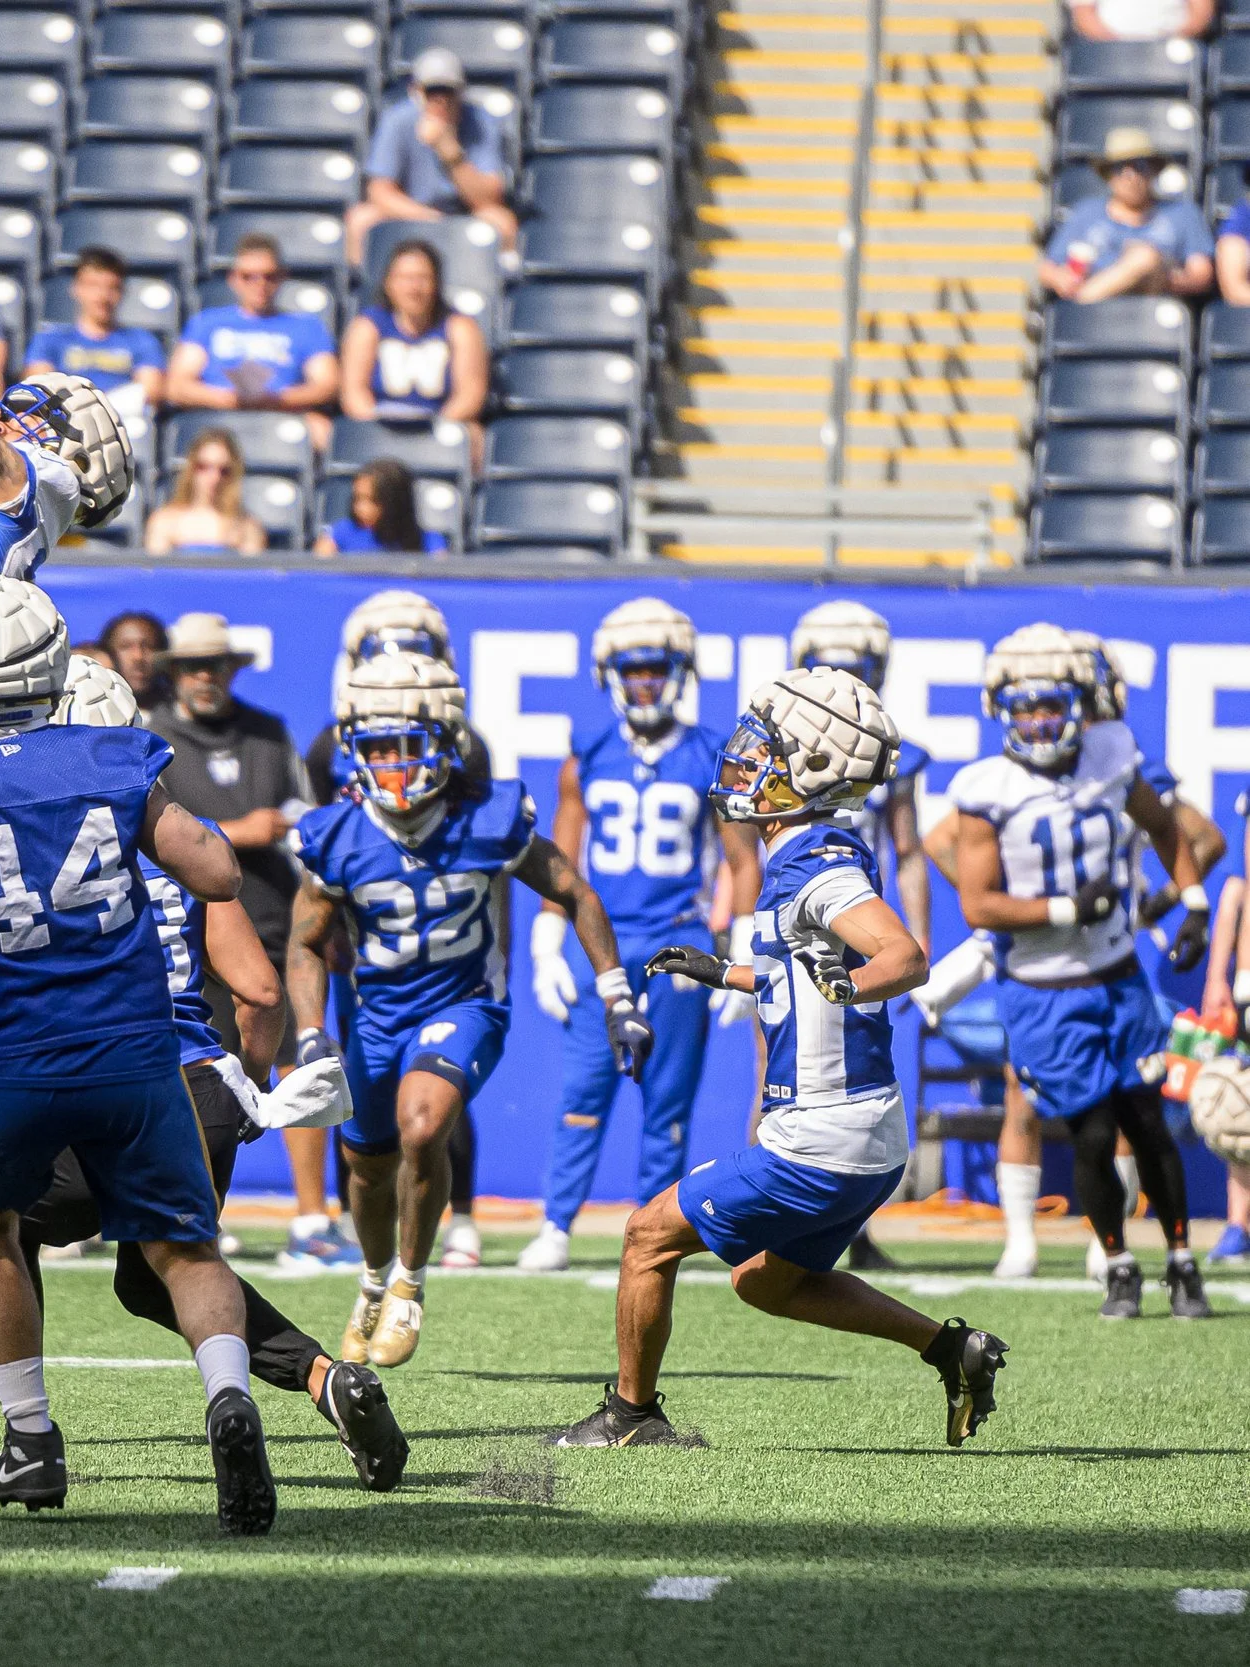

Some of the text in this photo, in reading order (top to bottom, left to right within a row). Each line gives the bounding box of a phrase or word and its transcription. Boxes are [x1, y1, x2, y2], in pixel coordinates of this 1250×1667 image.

[379, 338, 449, 397] W
[586, 778, 700, 877] 38
[352, 870, 490, 970] 32
